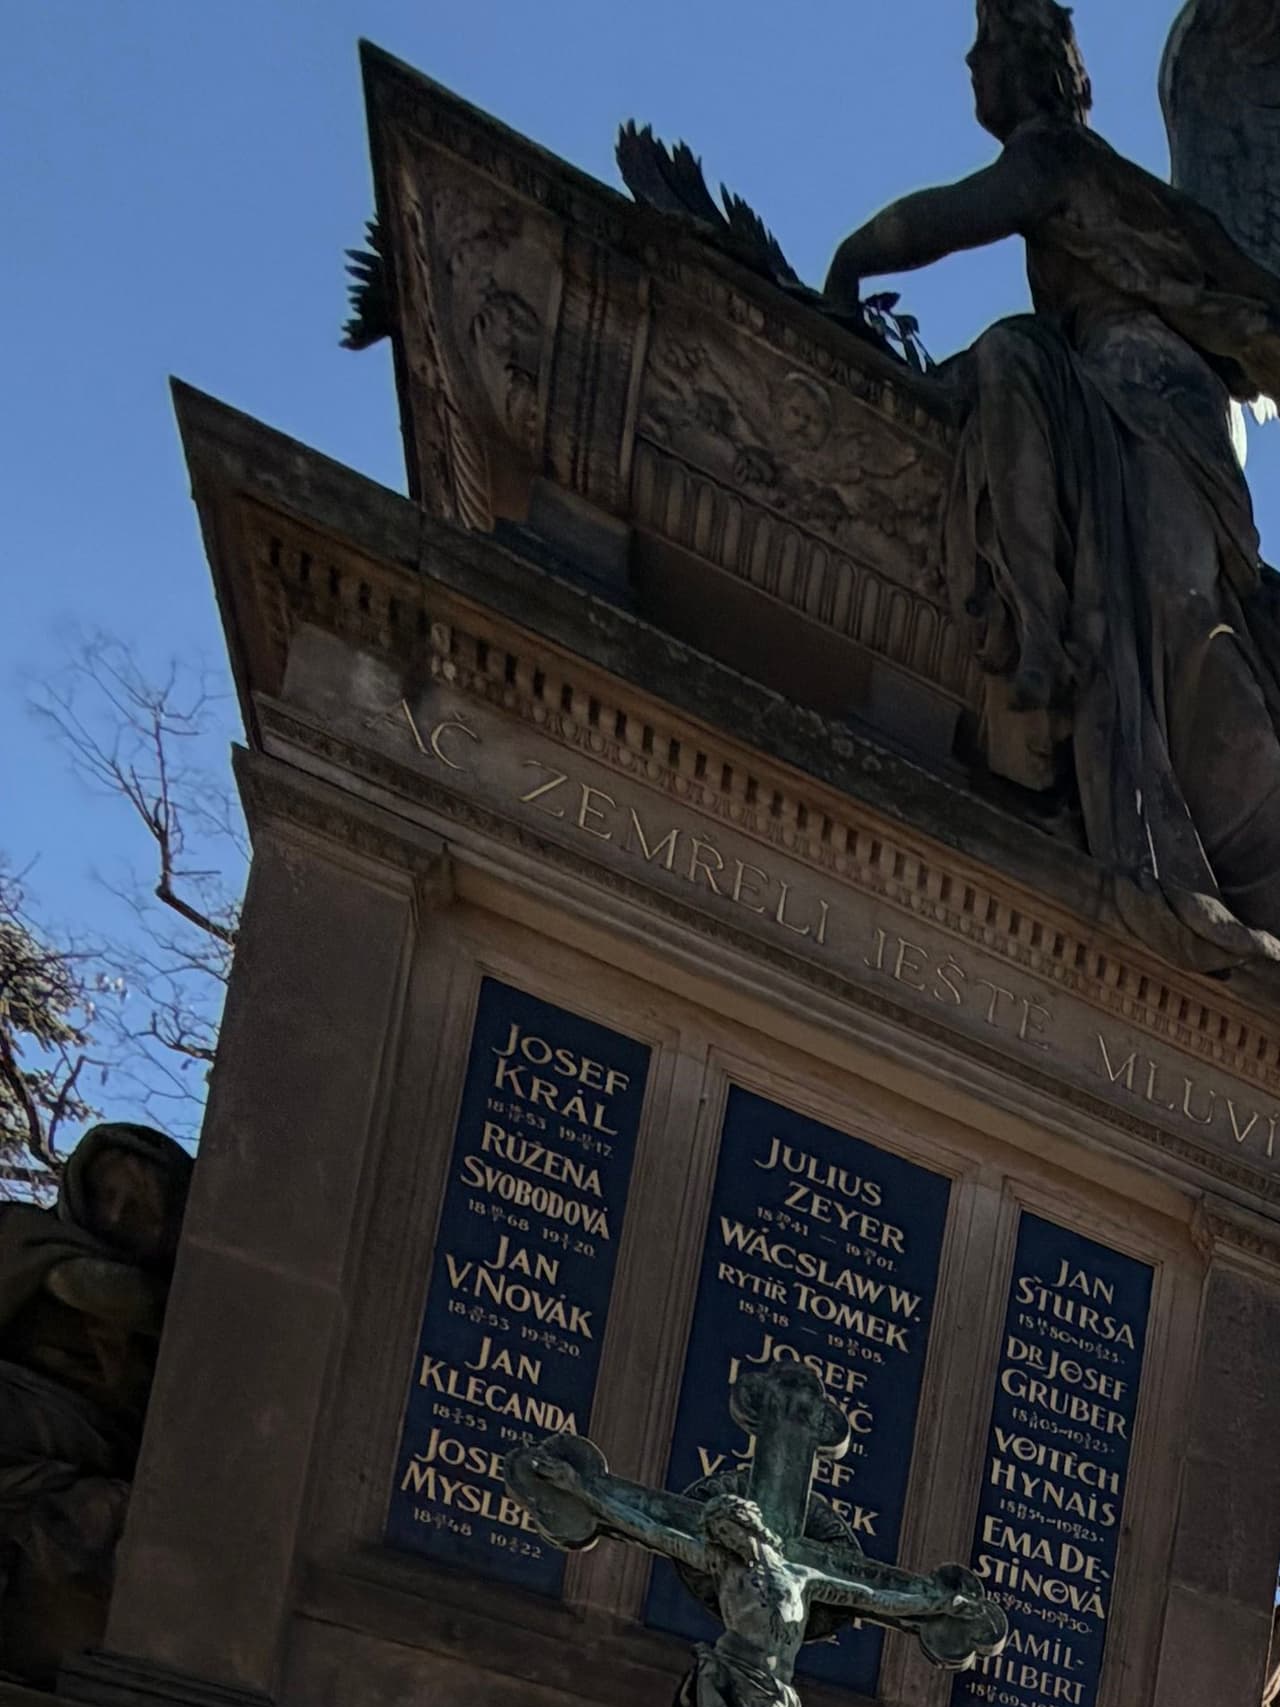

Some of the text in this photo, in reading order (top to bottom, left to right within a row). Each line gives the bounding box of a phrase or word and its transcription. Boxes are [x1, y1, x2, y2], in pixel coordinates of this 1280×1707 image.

[521, 760, 829, 944] ZEMŘELI
[864, 928, 1053, 1051] JEŠTĚ
[1098, 1032, 1279, 1158] MLUVÍ
[491, 1023, 631, 1096] JOSEF
[494, 1056, 619, 1137] KRÁL
[481, 1120, 603, 1199] RŮŽENA
[753, 1136, 882, 1207] JULIUS
[460, 1155, 610, 1241] SVOBODOVÁ
[783, 1180, 905, 1255] ZEYER
[483, 1235, 560, 1286] JAN
[720, 1215, 886, 1304] WÁCSLAW
[887, 1284, 922, 1323] W.
[1051, 1259, 1115, 1305] JAN
[718, 1261, 788, 1305] RYTÍŘ
[793, 1282, 911, 1354] TOMEK
[1015, 1275, 1135, 1350] ŠTURSA
[419, 1354, 577, 1436] KLECANDA
[464, 1336, 542, 1385] JAN
[1045, 1350, 1128, 1402] JOSEF
[1000, 1368, 1128, 1440] GRUBER
[414, 1427, 505, 1482] JOSE
[401, 1459, 540, 1535] MYSLBE
[982, 1514, 1054, 1567] EMA
[1005, 1628, 1085, 1671] AMIL-
